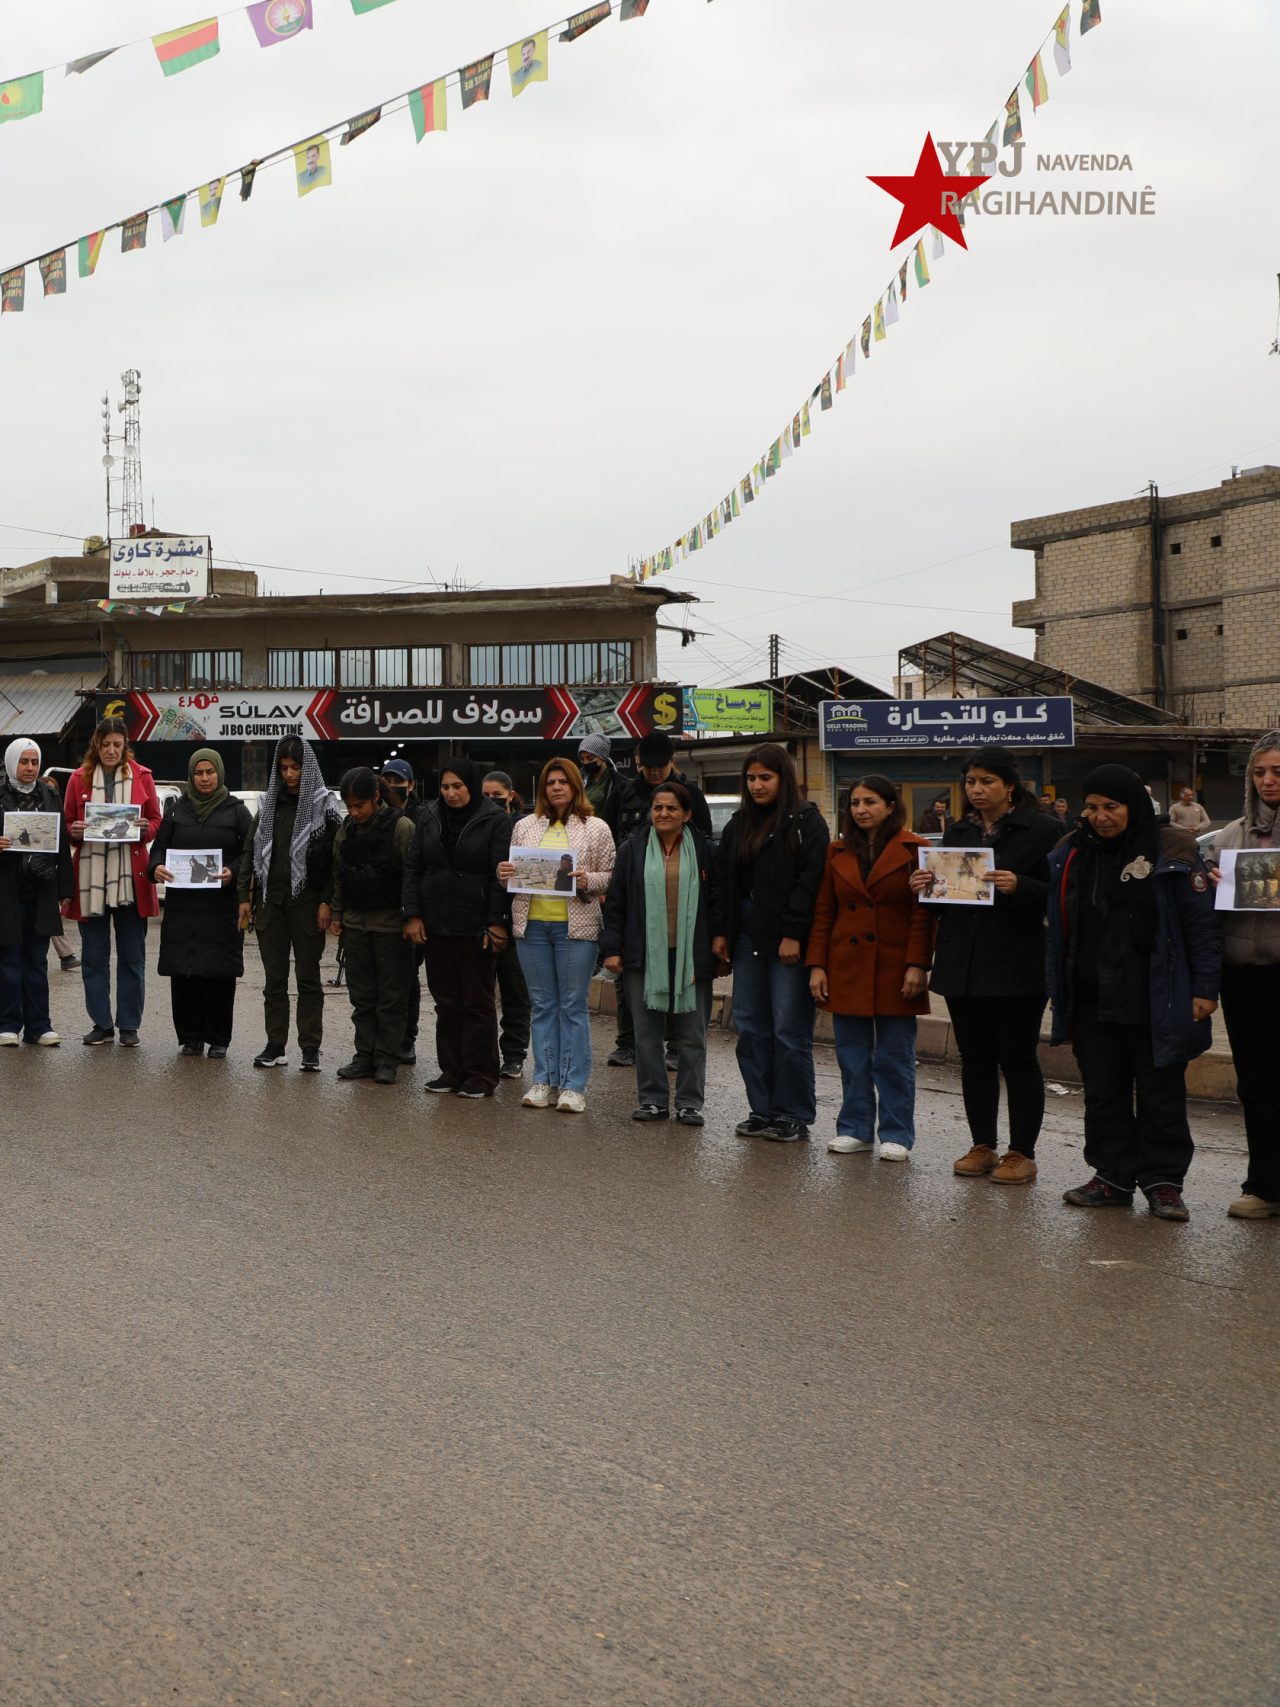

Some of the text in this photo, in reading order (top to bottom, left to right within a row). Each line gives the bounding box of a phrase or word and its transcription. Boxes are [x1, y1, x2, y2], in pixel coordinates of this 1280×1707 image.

[112, 539, 204, 563] منشرة كاوى
[113, 567, 199, 579] رخام حجر بلاط بلوك
[219, 700, 304, 718] SÛLAV
[340, 696, 542, 733] سولاف للصرافة
[887, 703, 1048, 731] كلو للتجارة
[219, 721, 304, 736] JI BO GUHERTINÊ
[933, 735, 955, 743] عقارية
[956, 733, 975, 744] أراضي
[980, 734, 1000, 743] تجارية
[1026, 733, 1046, 741] سكنية
[1047, 733, 1065, 741] شقق
